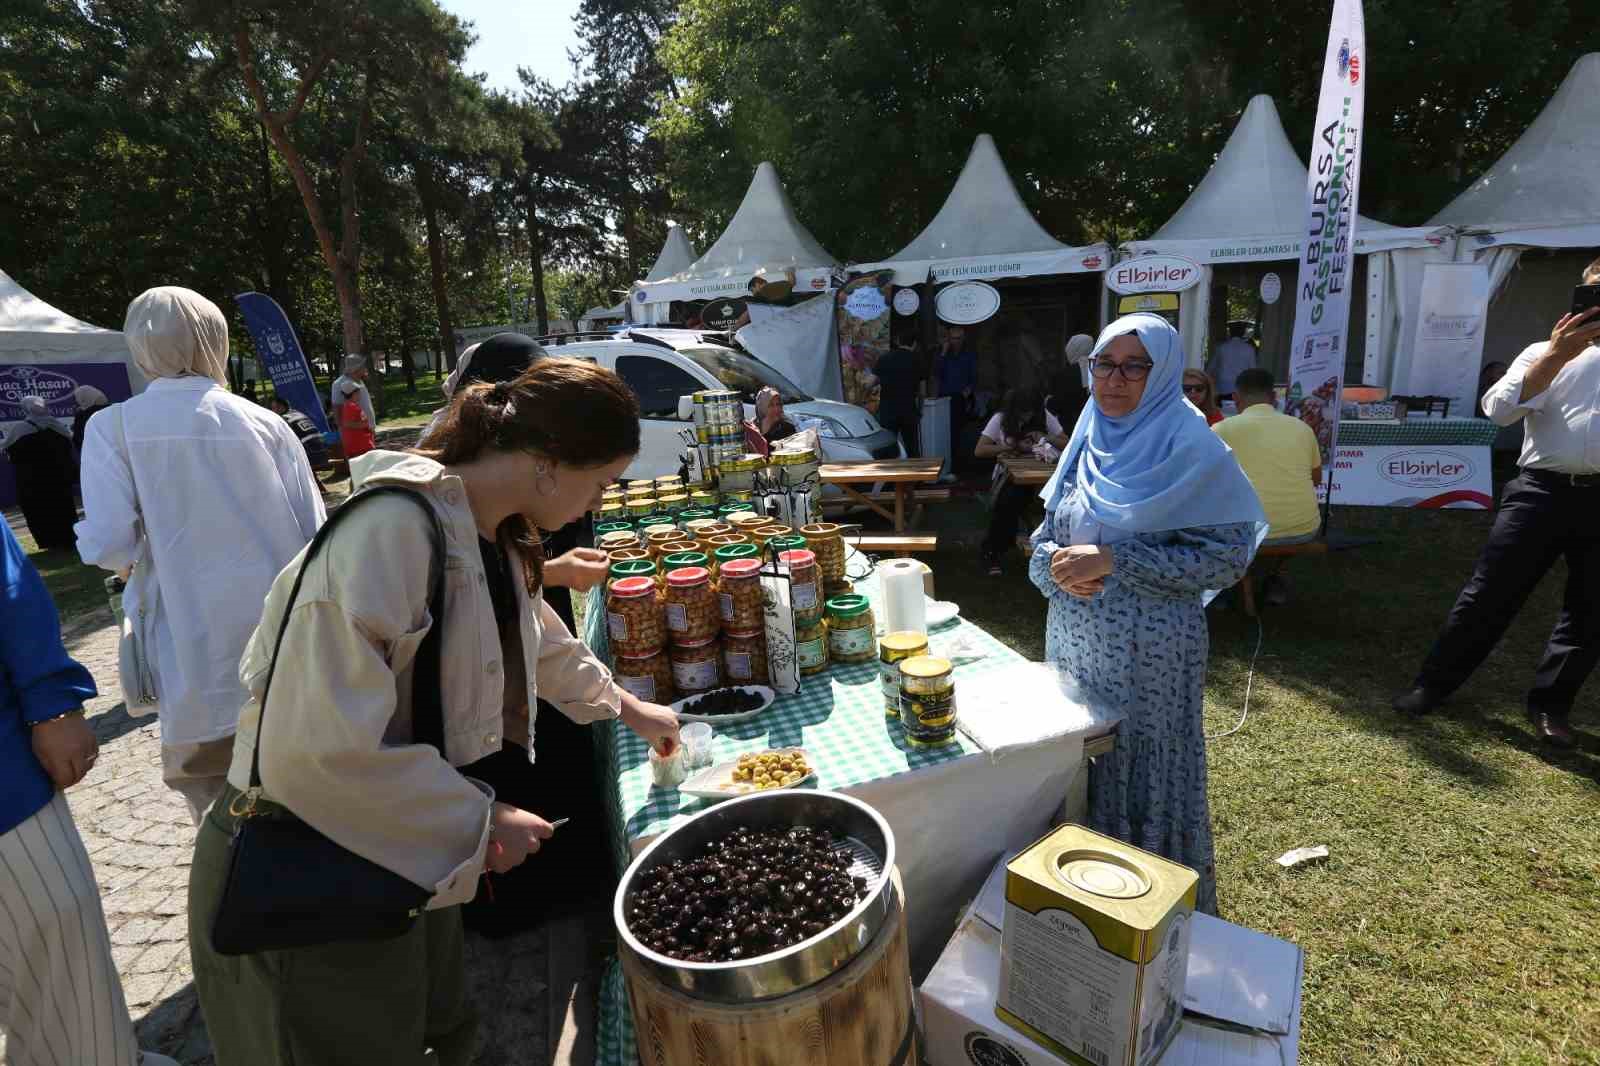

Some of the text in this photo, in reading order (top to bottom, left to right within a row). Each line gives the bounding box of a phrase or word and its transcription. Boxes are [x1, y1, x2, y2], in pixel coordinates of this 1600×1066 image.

[1117, 265, 1192, 284] Elbirler
[24, 378, 71, 391] Hasan
[1388, 460, 1464, 476] Elbirler
